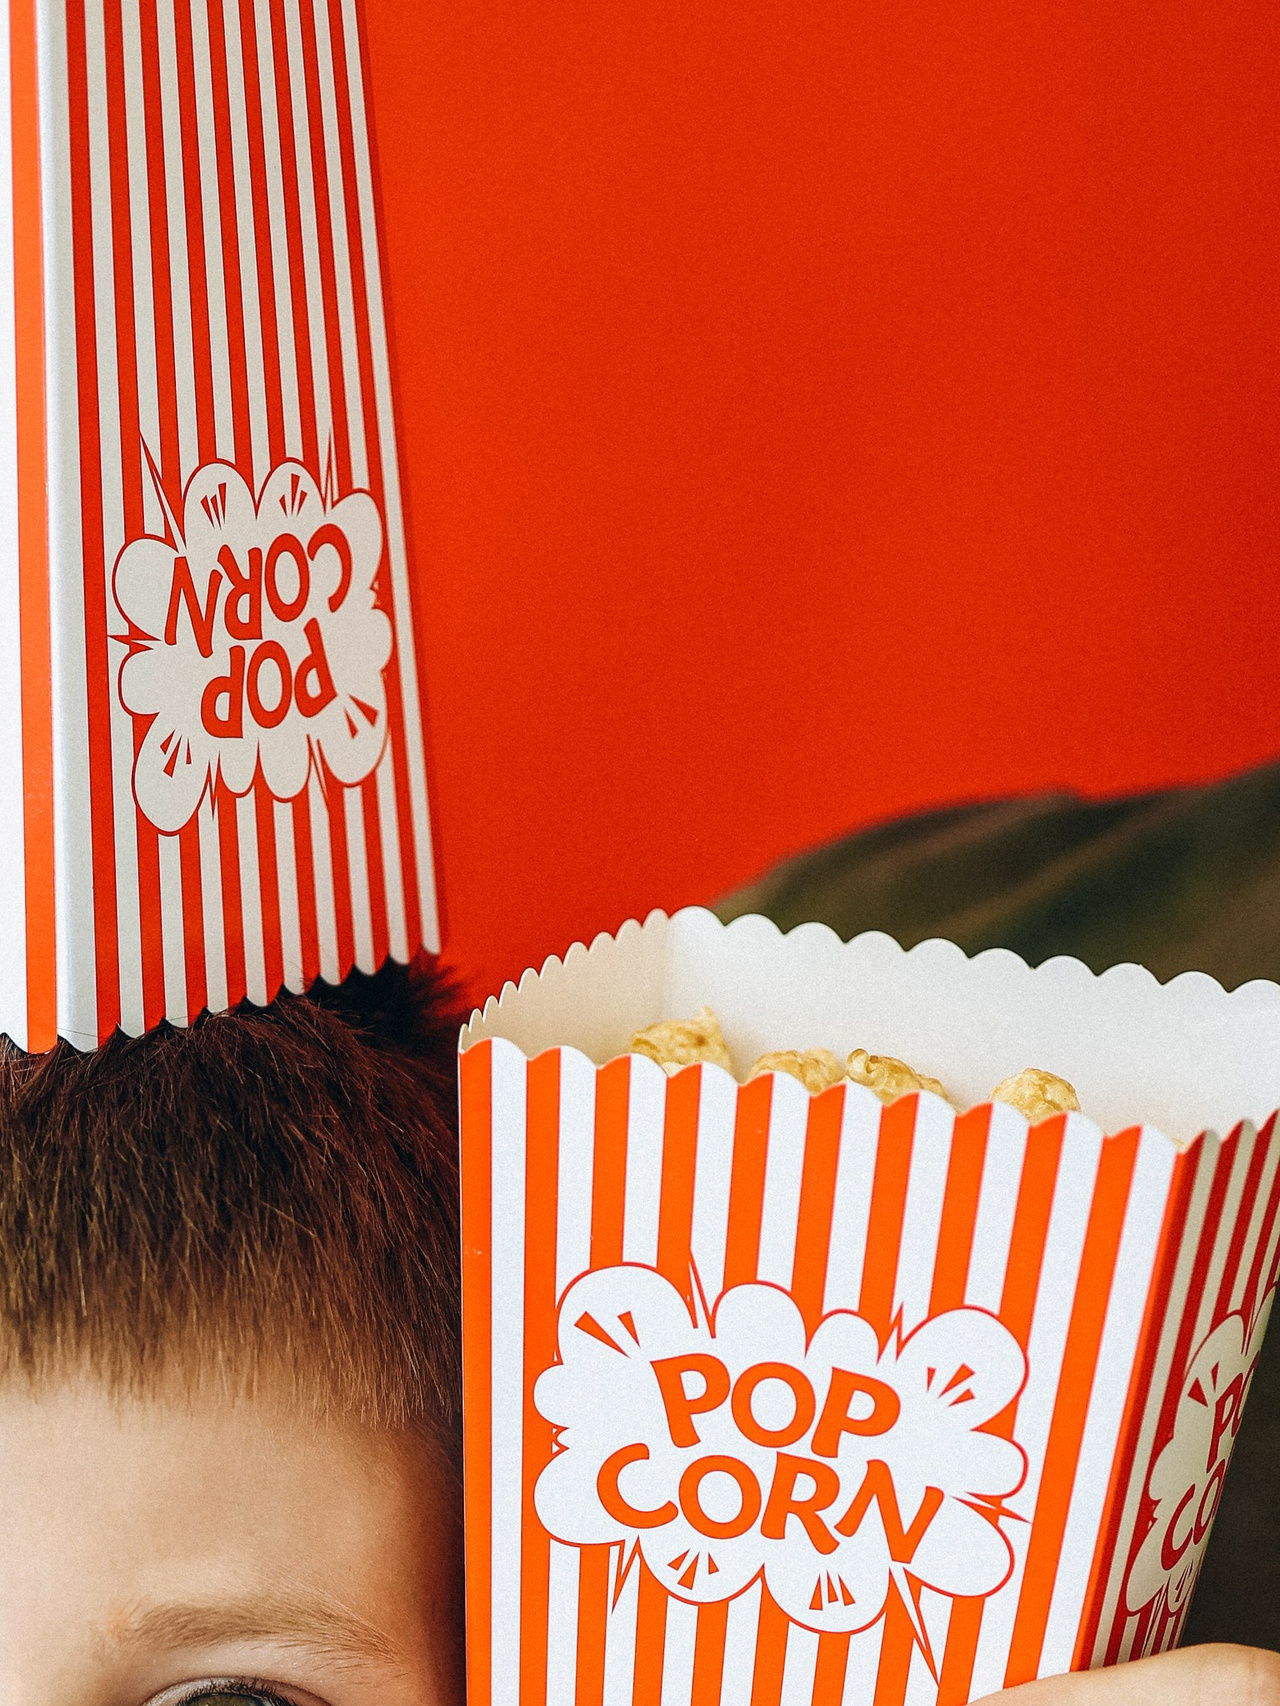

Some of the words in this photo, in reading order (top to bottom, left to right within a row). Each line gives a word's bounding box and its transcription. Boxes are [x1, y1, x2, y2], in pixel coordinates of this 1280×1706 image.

[164, 523, 353, 658] CORN
[200, 617, 338, 739] POP
[650, 1352, 901, 1458] POP
[596, 1443, 945, 1565] CORN
